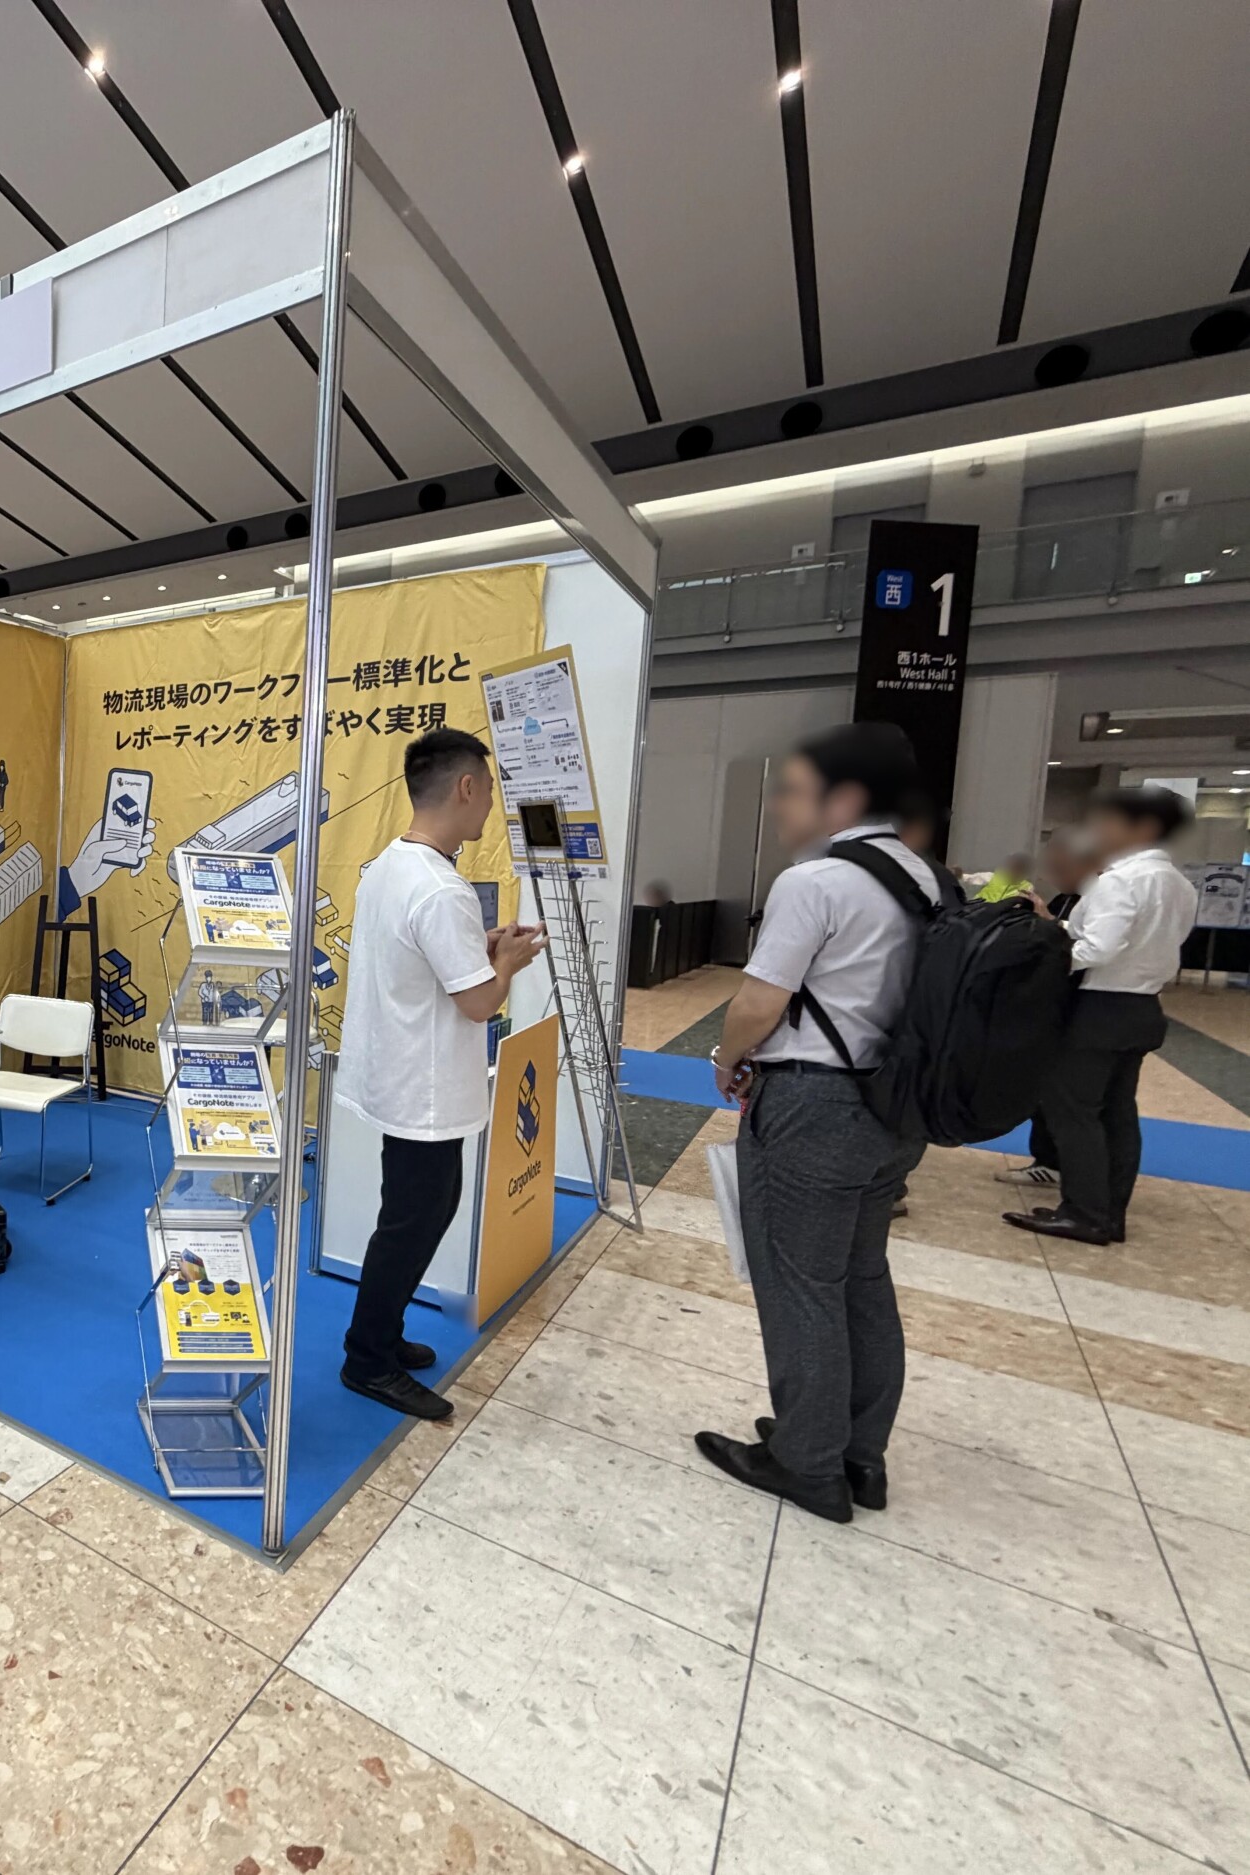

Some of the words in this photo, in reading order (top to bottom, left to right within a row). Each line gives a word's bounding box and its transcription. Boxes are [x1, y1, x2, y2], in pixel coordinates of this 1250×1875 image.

[886, 574, 903, 583] West
[885, 584, 903, 606] 西
[930, 572, 955, 637] 1
[897, 650, 957, 667] 西1ホール
[900, 667, 925, 679] West
[927, 668, 948, 680] Hall
[950, 669, 956, 681] 1
[102, 652, 471, 716] 物流現場のワークフー標準化と
[203, 898, 251, 909] CargoNote
[92, 1028, 155, 1053] goNote
[187, 1097, 235, 1108] CargoNote
[508, 1160, 541, 1198] CargoNote
